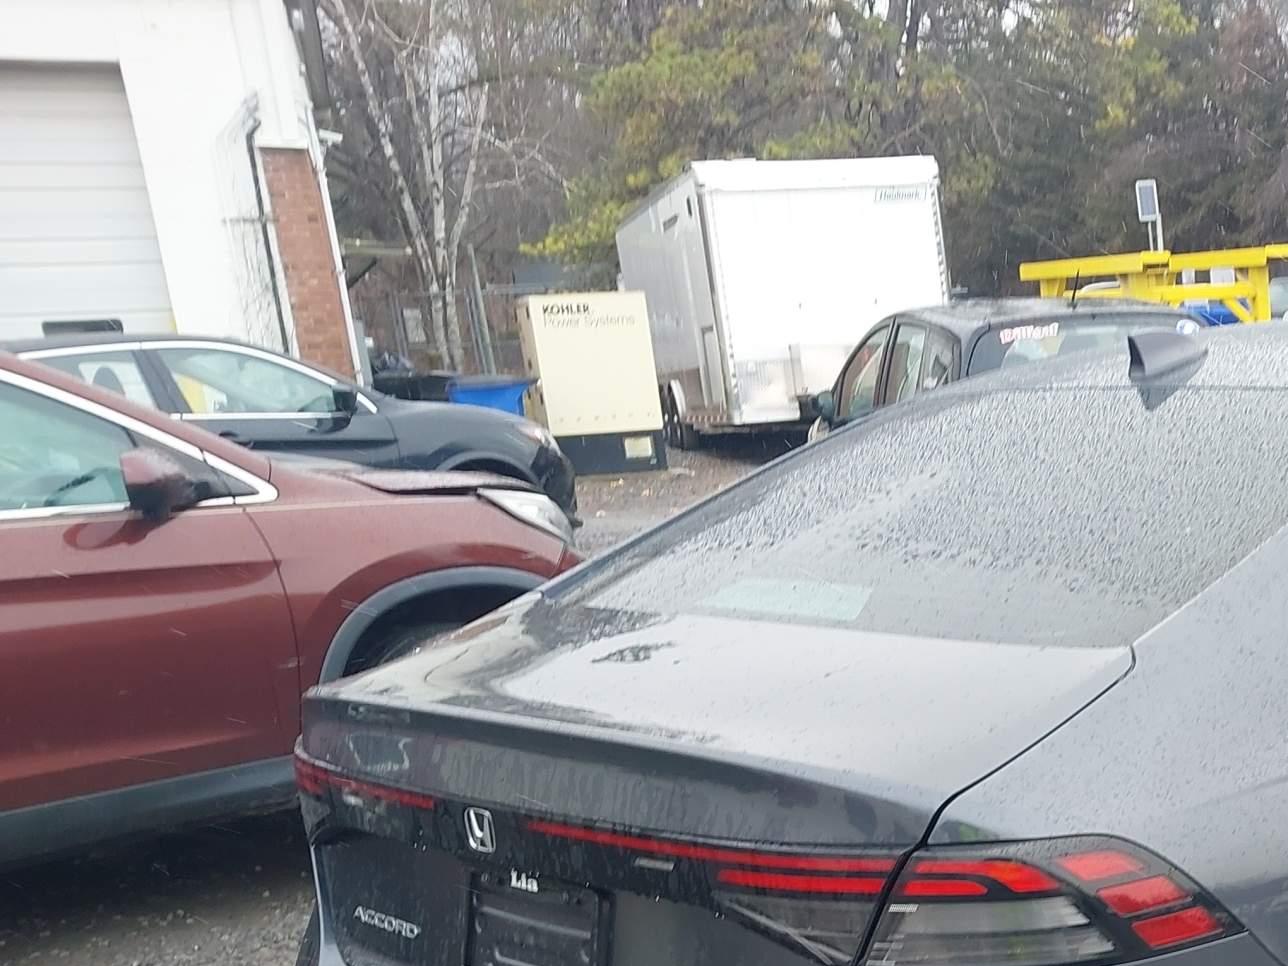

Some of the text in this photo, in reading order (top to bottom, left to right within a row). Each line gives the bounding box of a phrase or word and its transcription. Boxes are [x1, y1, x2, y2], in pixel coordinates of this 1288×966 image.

[542, 303, 590, 315] KOHLER
[544, 313, 635, 328] Power Systems
[511, 868, 539, 893] Lia
[353, 905, 419, 939] ACCORD
